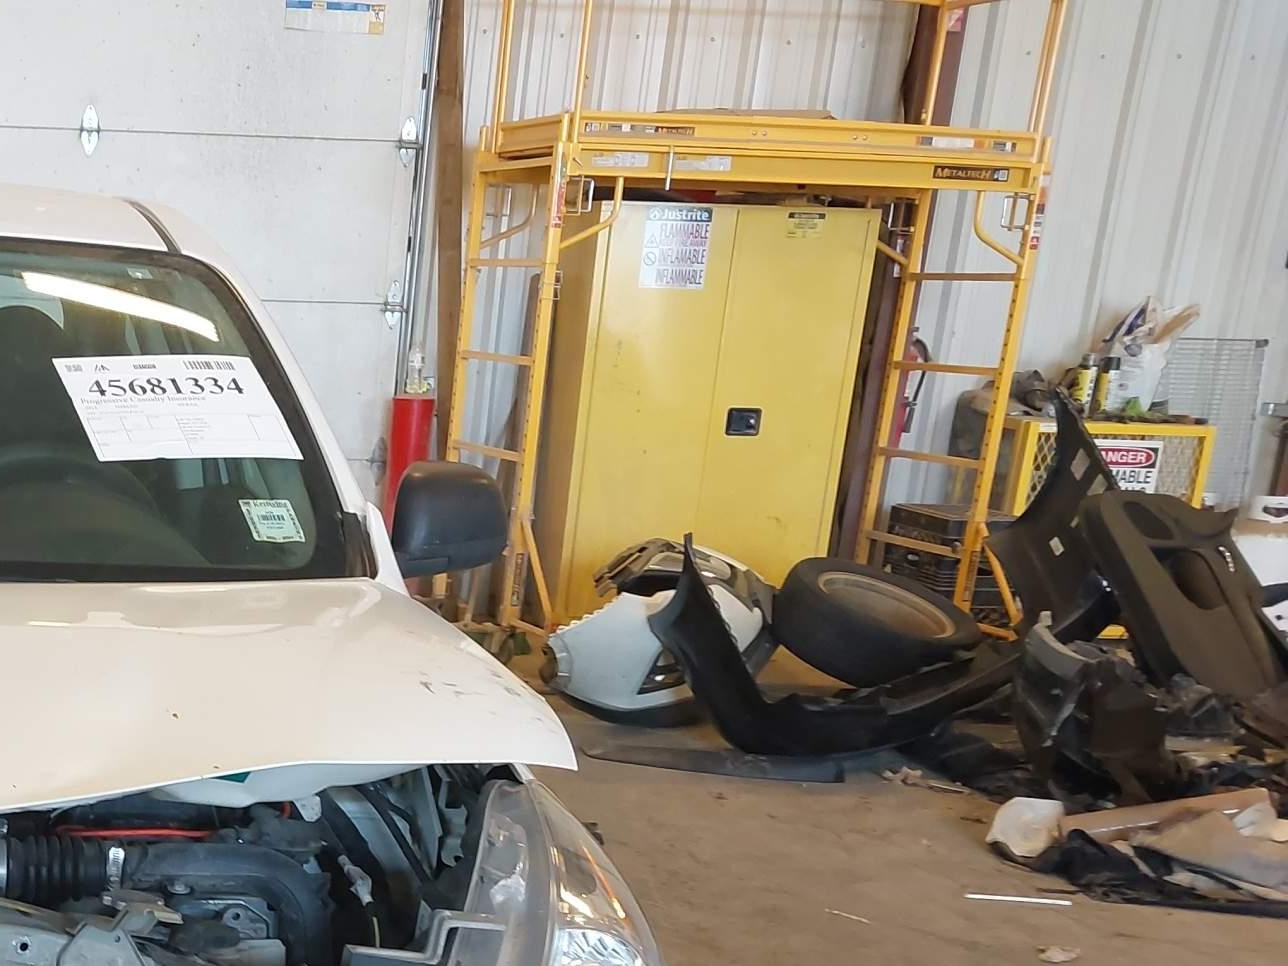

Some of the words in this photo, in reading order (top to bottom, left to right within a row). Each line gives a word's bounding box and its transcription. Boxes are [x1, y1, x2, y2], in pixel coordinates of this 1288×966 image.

[934, 167, 992, 180] METALTECH
[662, 208, 710, 221] Justrite
[659, 223, 710, 240] FLAMMABLE
[656, 267, 704, 285] INFLAMMABLE
[88, 376, 244, 397] 45681334
